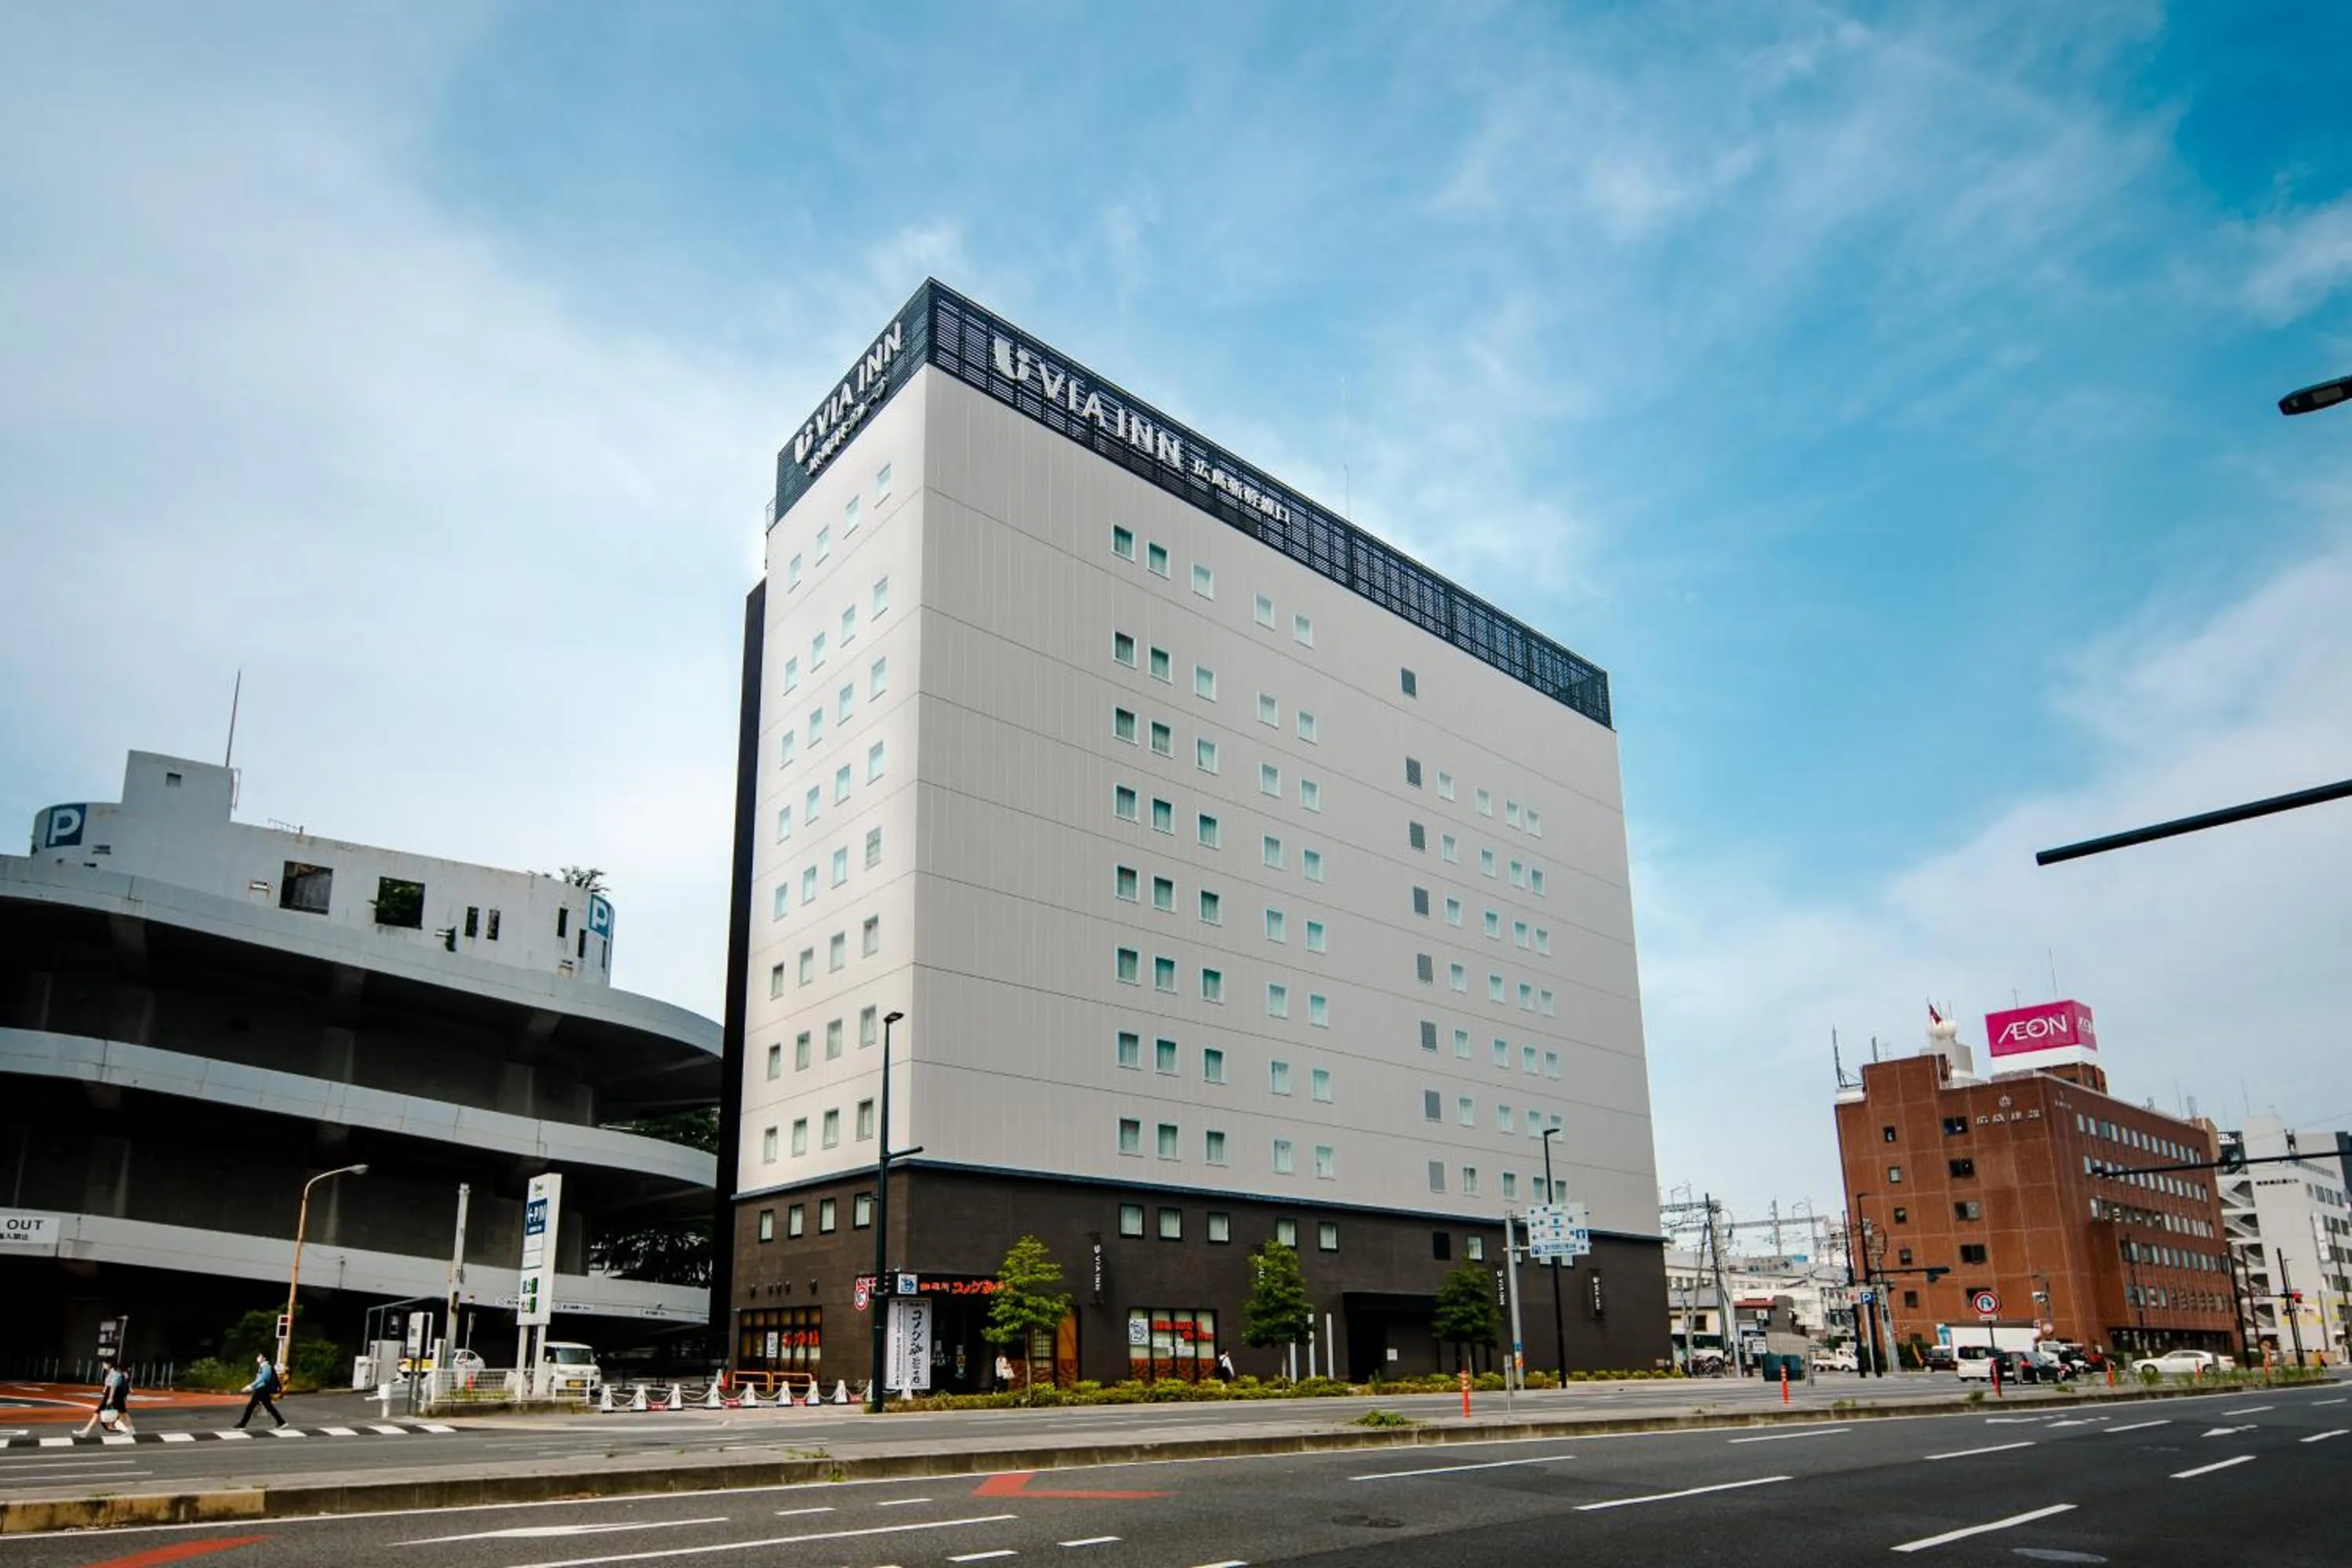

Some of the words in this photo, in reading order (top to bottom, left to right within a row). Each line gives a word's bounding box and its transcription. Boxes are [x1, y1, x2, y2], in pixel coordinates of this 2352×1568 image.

[815, 381, 854, 437] VIA
[858, 321, 901, 392] INN
[1038, 361, 1106, 428] VIA
[1116, 406, 1181, 470] INN
[49, 808, 81, 844] P
[591, 898, 608, 929] P
[7, 1219, 44, 1230] OUT
[1862, 1293, 1871, 1305] P
